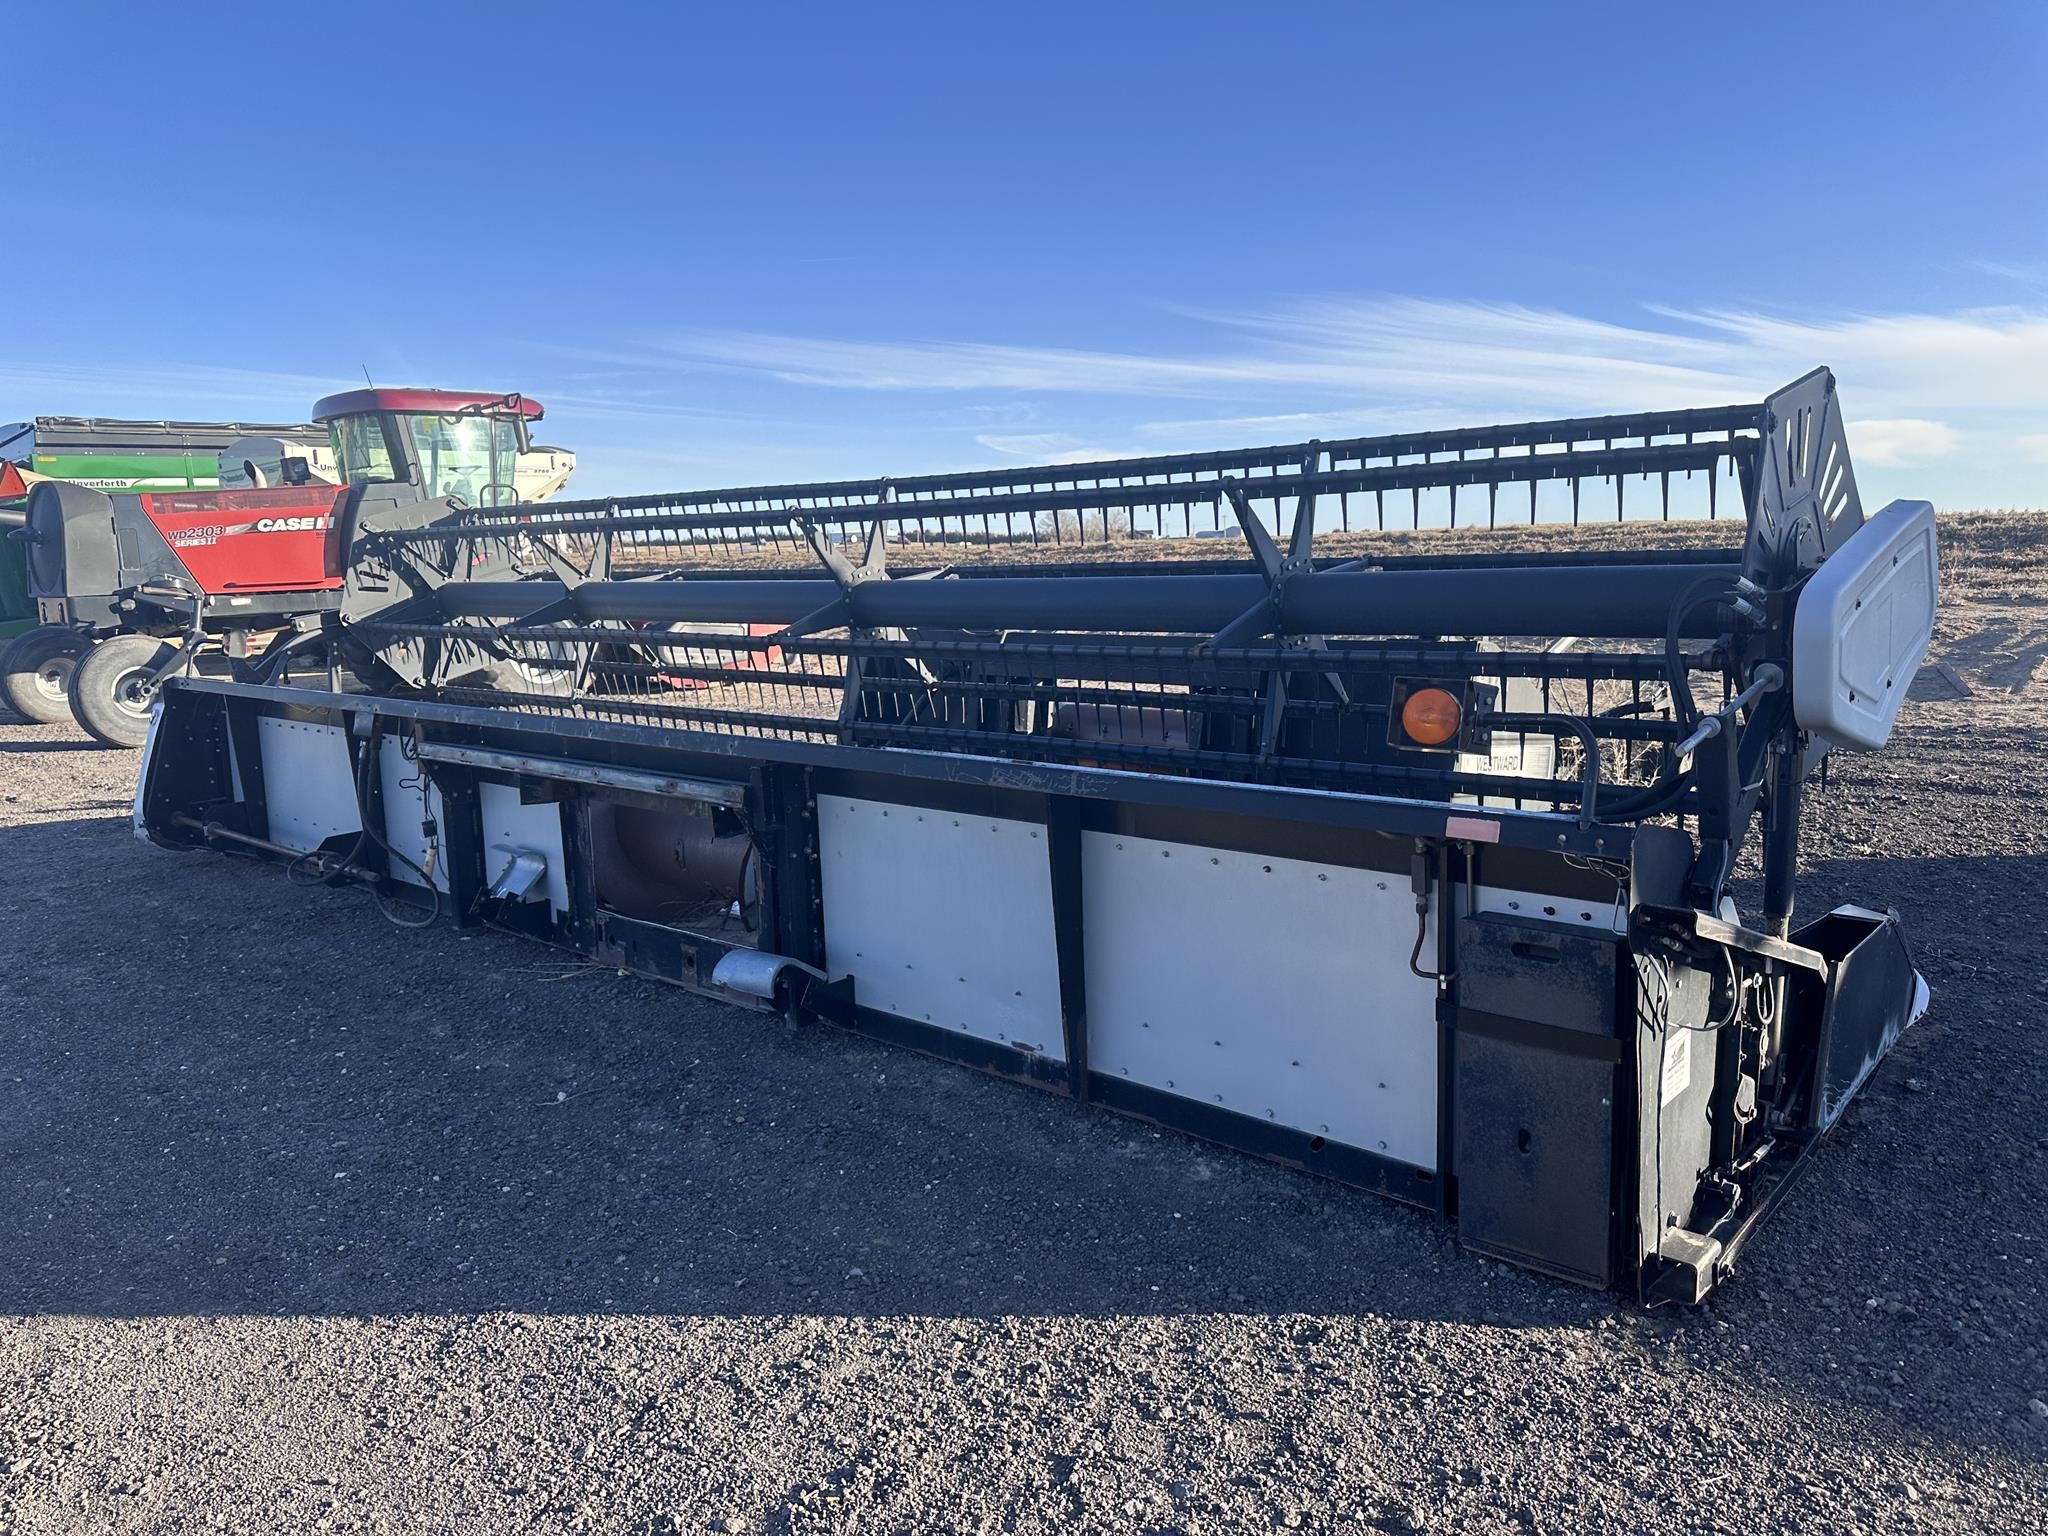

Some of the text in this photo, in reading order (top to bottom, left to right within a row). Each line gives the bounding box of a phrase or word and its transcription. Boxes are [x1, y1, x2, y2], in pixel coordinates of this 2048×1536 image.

[257, 518, 314, 532] CASE
[168, 526, 223, 540] WD2303
[175, 538, 206, 548] SERIES
